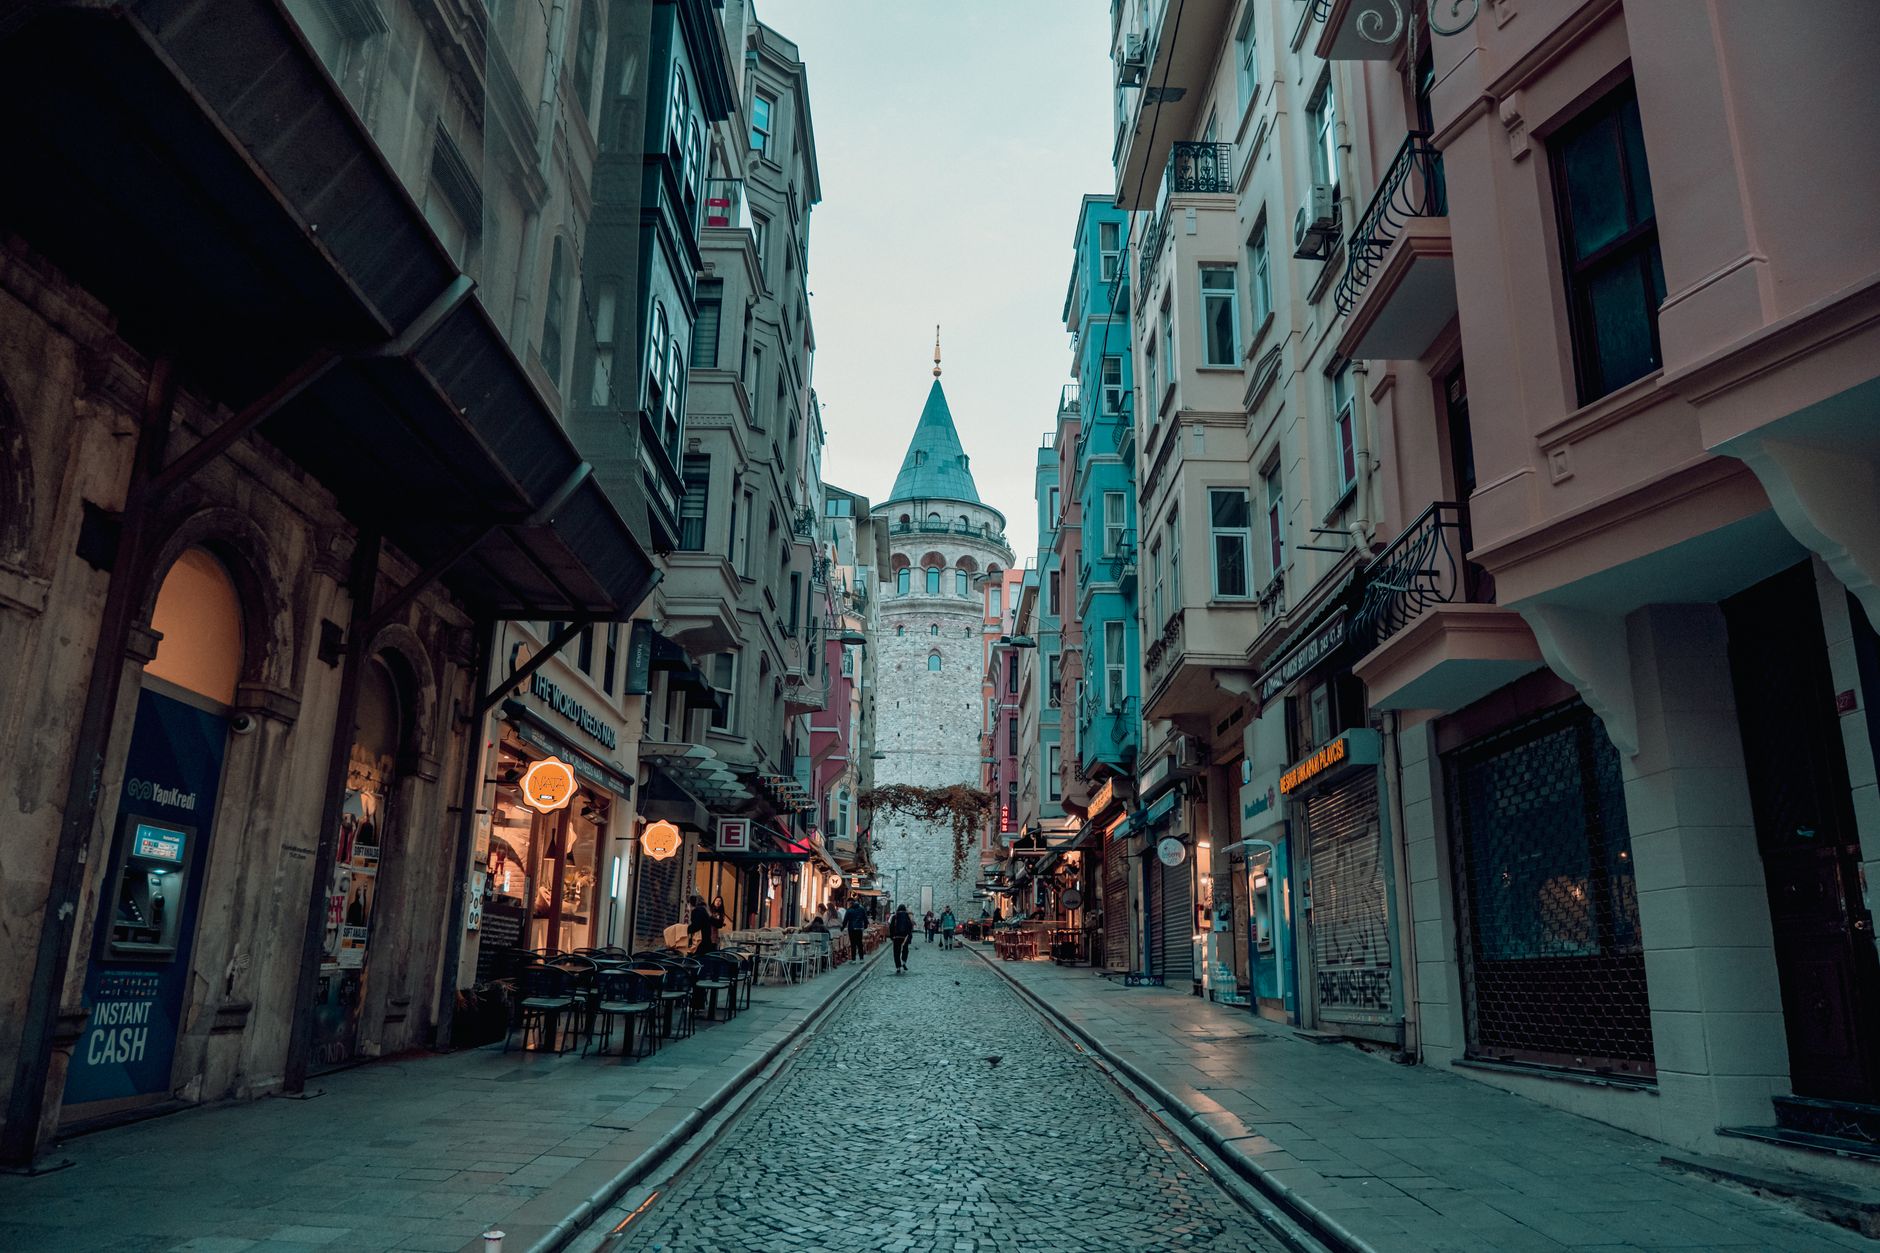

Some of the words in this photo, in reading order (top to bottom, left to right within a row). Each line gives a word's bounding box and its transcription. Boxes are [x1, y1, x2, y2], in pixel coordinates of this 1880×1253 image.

[533, 672, 552, 702] THE
[551, 685, 579, 722] WORLD
[579, 706, 601, 741] NEEDS
[600, 722, 616, 750] NATA
[725, 825, 741, 844] E
[343, 926, 353, 938] SOFT
[352, 927, 367, 939] ANALOG
[93, 1001, 152, 1026] INSTANT
[87, 1027, 148, 1066] CASH
